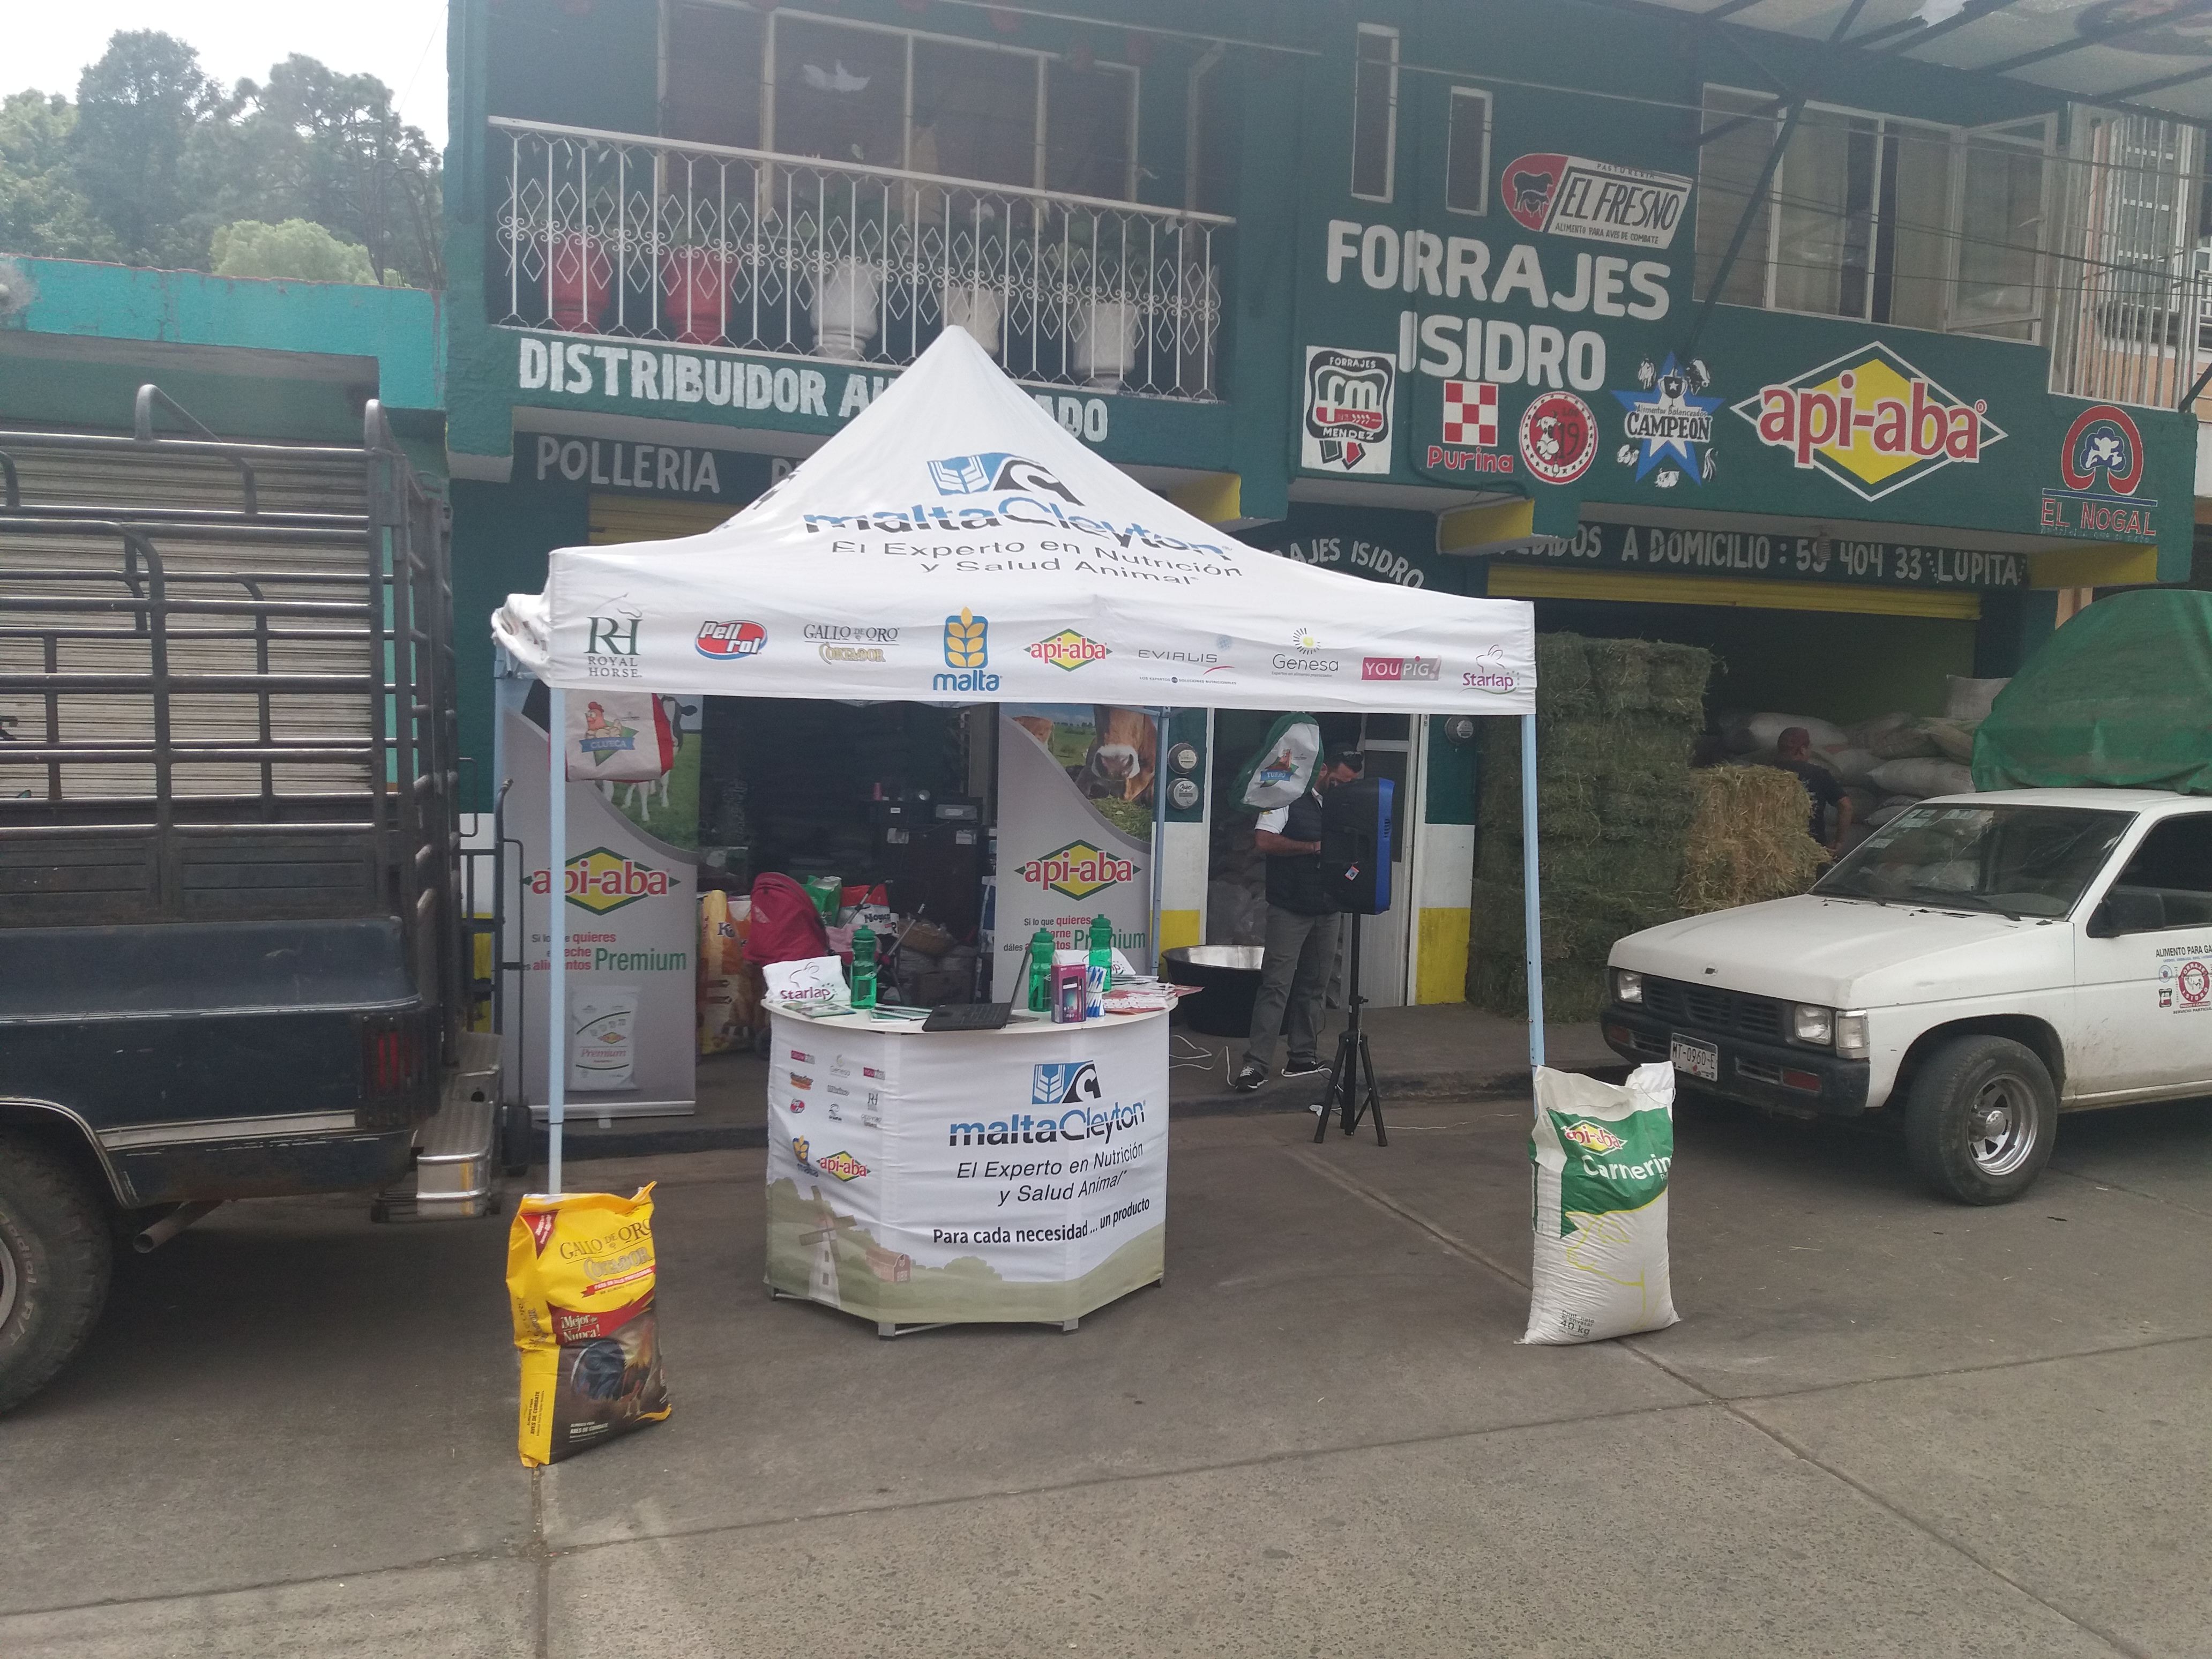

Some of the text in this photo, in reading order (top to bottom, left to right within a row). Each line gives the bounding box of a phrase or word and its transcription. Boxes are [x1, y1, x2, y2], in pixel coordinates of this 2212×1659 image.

[1560, 176, 1680, 230] EL FRESNO
[1555, 222, 1659, 245] ALIMENTO PARA AVES DE COMBATE
[1326, 219, 1671, 320] FORRAJES
[1329, 356, 1376, 369] FORRAJES
[1399, 310, 1606, 392] ISIDRO
[519, 337, 829, 417] DISTRIBUIDOR
[1636, 404, 1708, 417] Alimentos Balanceados
[1757, 371, 1981, 466] api-aba
[1322, 427, 1374, 440] MENDEZ
[1627, 412, 1711, 440] CAMPEON
[1558, 422, 1579, 459] 19
[537, 435, 720, 494] POLLERIA
[2041, 498, 2071, 527] EL
[2080, 502, 2156, 536] NOGAL
[832, 540, 1244, 577] El Experto en Nutrición
[1351, 540, 1424, 589] ISIDRO
[1621, 526, 1639, 562] A
[1649, 528, 1770, 570] DOMICILIO
[1840, 541, 1884, 577] 404
[1895, 546, 1922, 580] 33
[1938, 549, 2019, 586] LUPITA
[921, 557, 1192, 586] y Salud Animal
[584, 616, 644, 656] RH
[699, 620, 741, 640] Pell
[804, 624, 851, 642] GALLO
[865, 626, 898, 642] ORO
[726, 637, 761, 655] rol
[1030, 637, 1107, 664] api-aba
[1138, 649, 1217, 663] EVIALIS
[588, 655, 638, 667] ROYAL
[1273, 653, 1339, 672] Genesa
[933, 669, 1000, 692] malta
[1462, 672, 1514, 690] Starlap
[591, 738, 626, 749] CLUECA
[1024, 851, 1133, 890] api-aba
[1024, 918, 1031, 926] Si
[1041, 918, 1054, 926] que
[1056, 915, 1091, 926] quieres
[573, 932, 616, 944] quieres
[1004, 943, 1023, 951] dáles
[564, 946, 592, 957] eche
[595, 947, 687, 971] Premium
[2156, 946, 2186, 958] ALIMENTO
[2187, 945, 2203, 955] PARA
[2182, 987, 2208, 1000] ISIDRO
[949, 1102, 1146, 1147] maltaCleyton
[819, 1156, 867, 1178] api-aba
[956, 1142, 1144, 1181] El Experto en Nutrición
[997, 1171, 1124, 1207] y Salud Animal
[933, 1229, 969, 1244] Para
[973, 1227, 1011, 1244] cada
[1100, 1214, 1111, 1229] un
[1112, 1197, 1150, 1228] producto
[560, 1238, 603, 1260] GALLO
[604, 1233, 618, 1244] DE
[1578, 1325, 1590, 1336] kg
